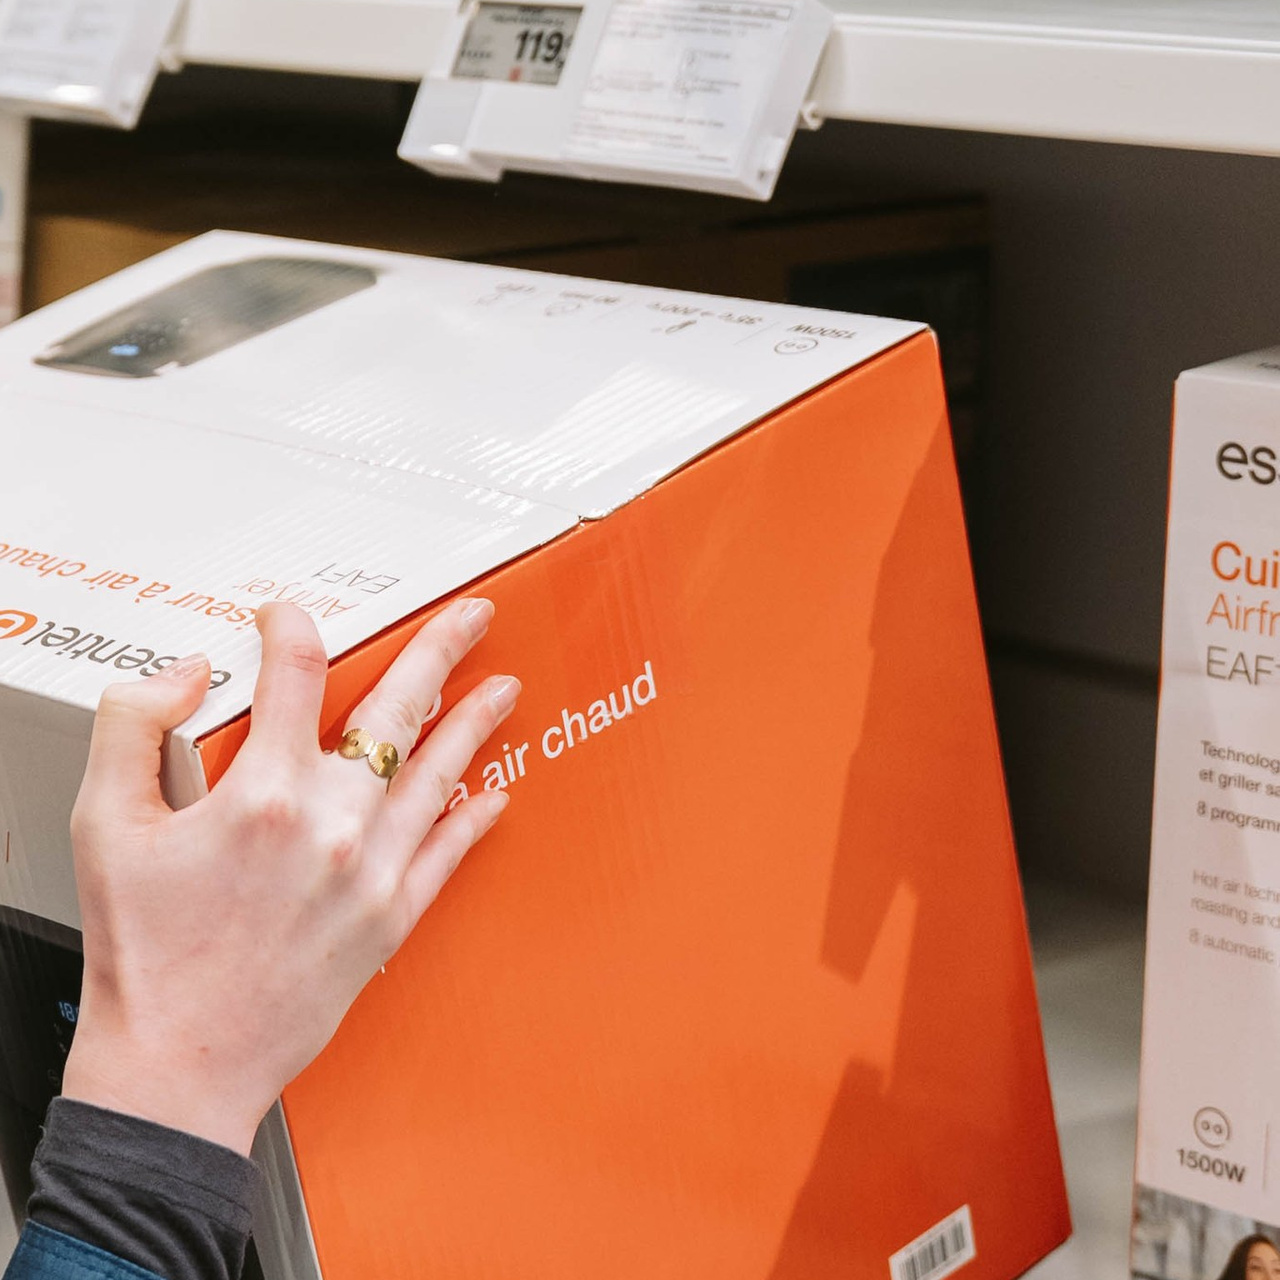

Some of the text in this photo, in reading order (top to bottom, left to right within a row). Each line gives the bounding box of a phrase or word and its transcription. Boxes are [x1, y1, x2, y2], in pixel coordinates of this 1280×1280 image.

[85, 567, 140, 590] air
[311, 562, 401, 594] EAF1
[163, 588, 257, 630] iseur
[481, 742, 530, 792] air
[541, 660, 658, 760] chaud
[1198, 768, 1214, 784] et
[1218, 770, 1261, 794] griller
[1192, 869, 1219, 888] Hot
[1222, 877, 1241, 895] air
[1190, 896, 1249, 925] roasting
[1203, 933, 1275, 964] automatic
[58, 1000, 80, 1022] 18
[1176, 1147, 1246, 1184] 1500W
